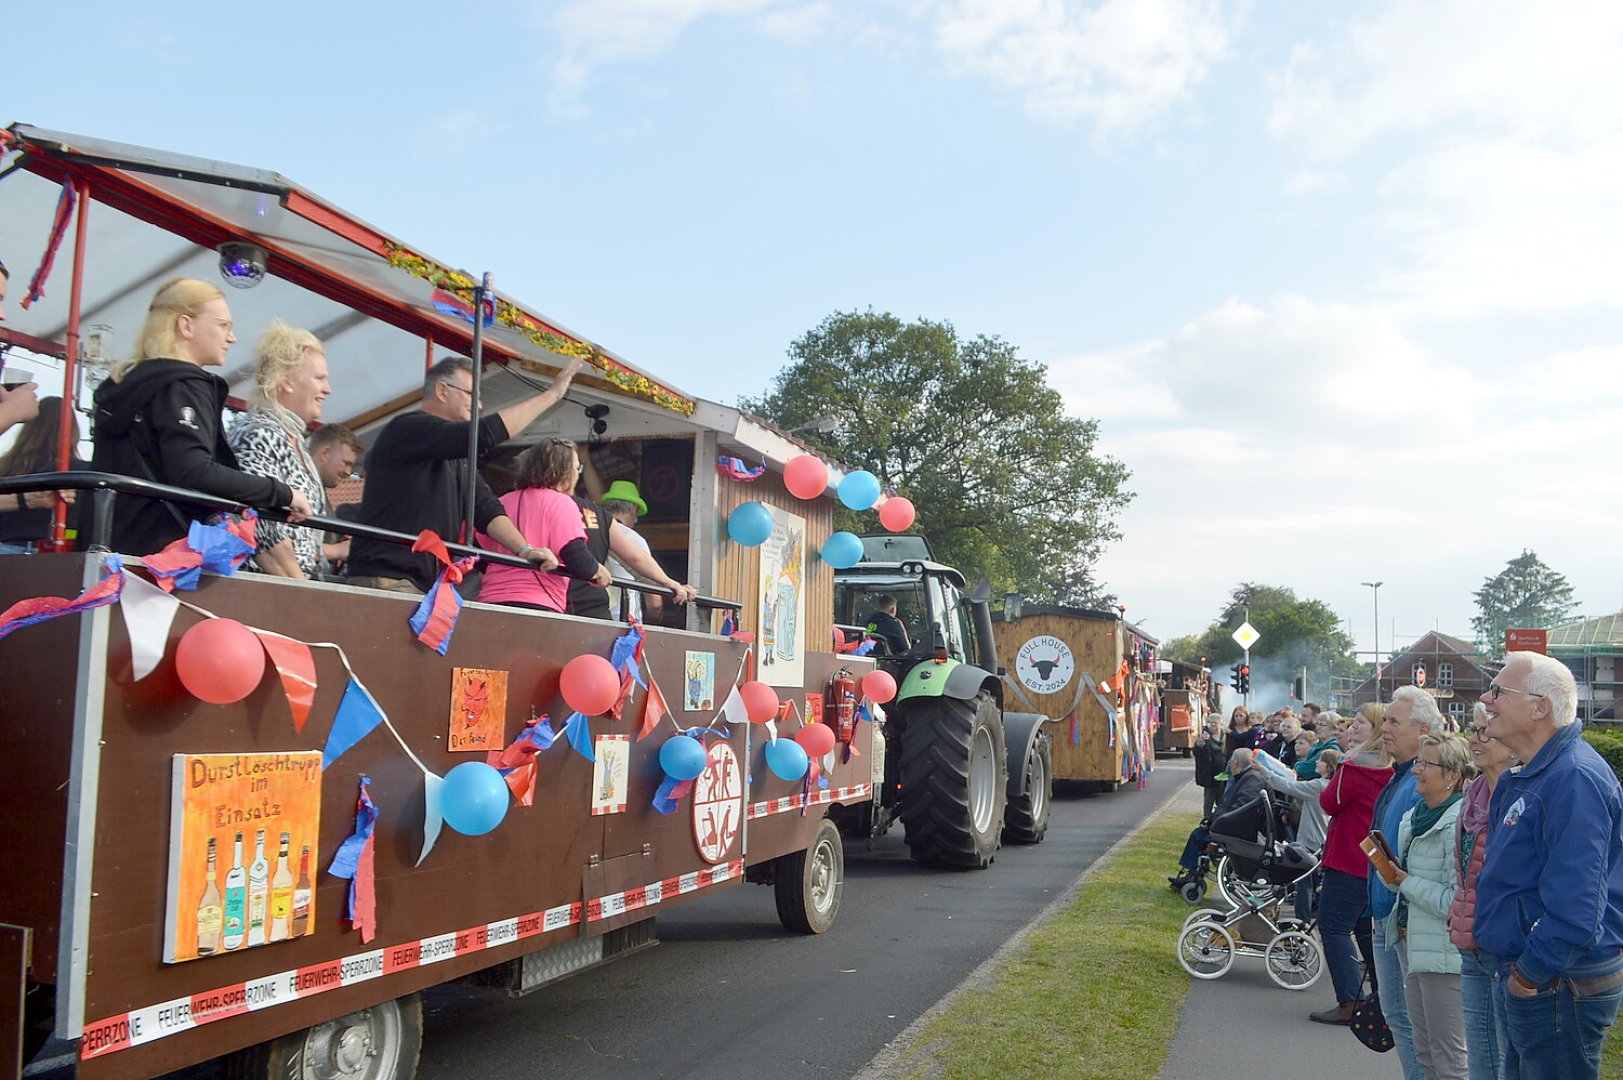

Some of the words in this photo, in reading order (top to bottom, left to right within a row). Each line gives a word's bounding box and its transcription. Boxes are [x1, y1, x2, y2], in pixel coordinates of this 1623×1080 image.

[1020, 640, 1040, 659] FULL
[1041, 637, 1070, 659] HOUSE
[1025, 678, 1044, 691] EST.
[1045, 678, 1066, 691] 2024
[191, 756, 320, 788] Durstlöschtrupp
[250, 776, 268, 793] im
[215, 797, 281, 828] Einsatz
[158, 981, 277, 1030] FEUERWEHR-SPERRZONE
[288, 954, 384, 994] FEUERWEHR-SPERRZONE
[393, 934, 470, 968] FEUERWEHR-SPERRZONE
[475, 916, 541, 946] FEUERWEHR-SPERRZONE
